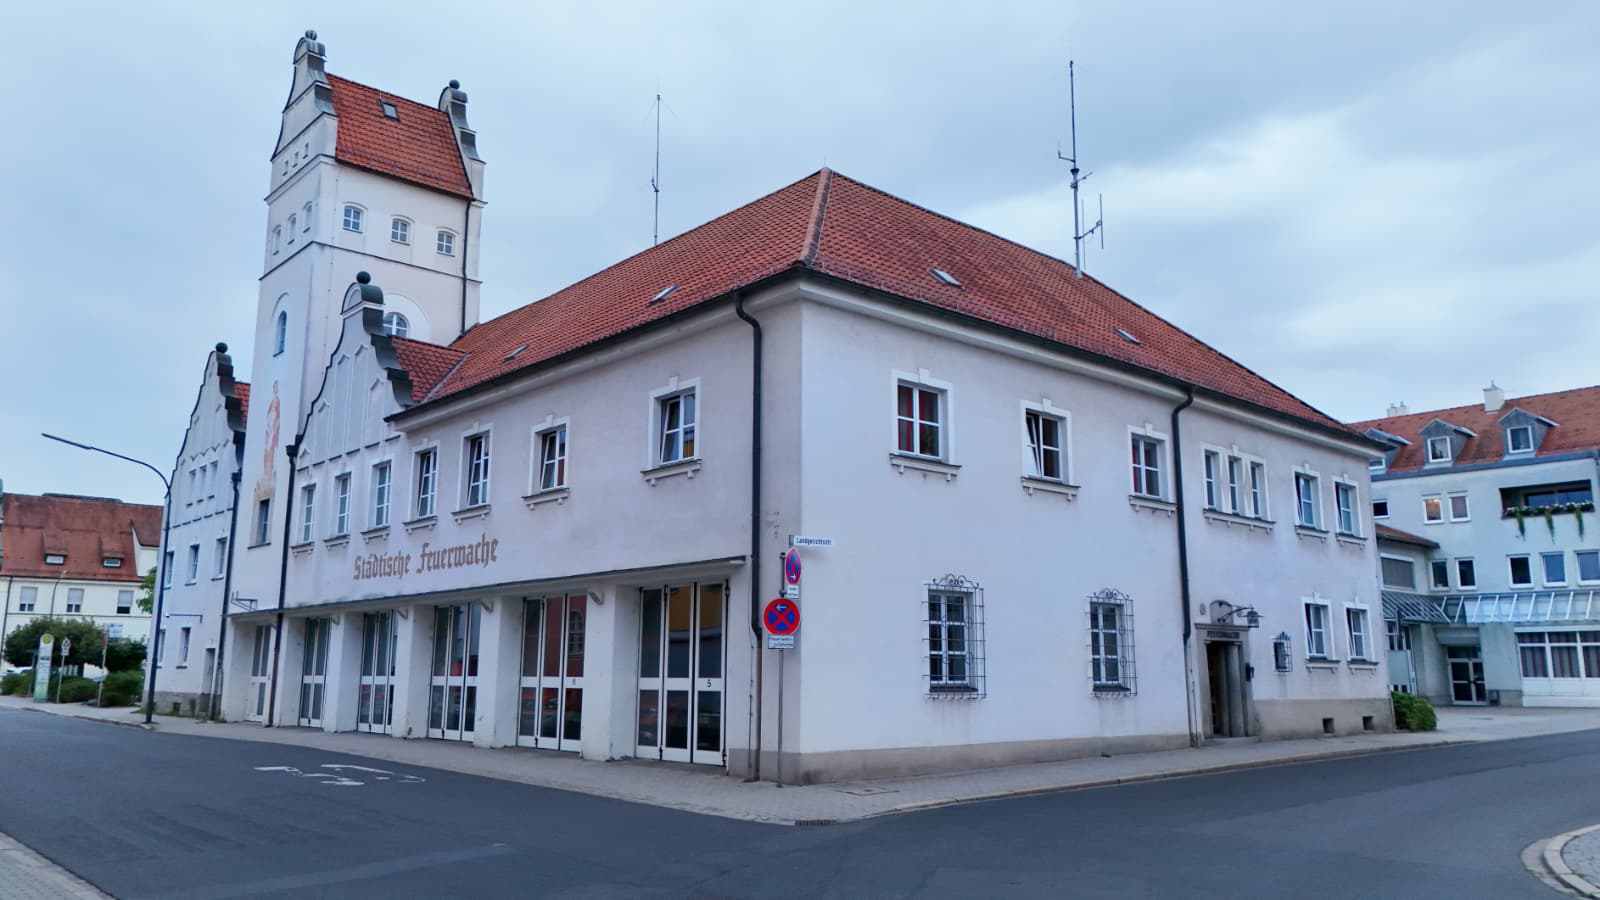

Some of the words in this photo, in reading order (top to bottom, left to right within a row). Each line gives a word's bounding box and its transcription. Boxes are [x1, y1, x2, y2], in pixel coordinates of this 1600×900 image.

[353, 550, 411, 580] Städtische
[416, 533, 498, 574] Feuerwache
[707, 679, 711, 688] 5
